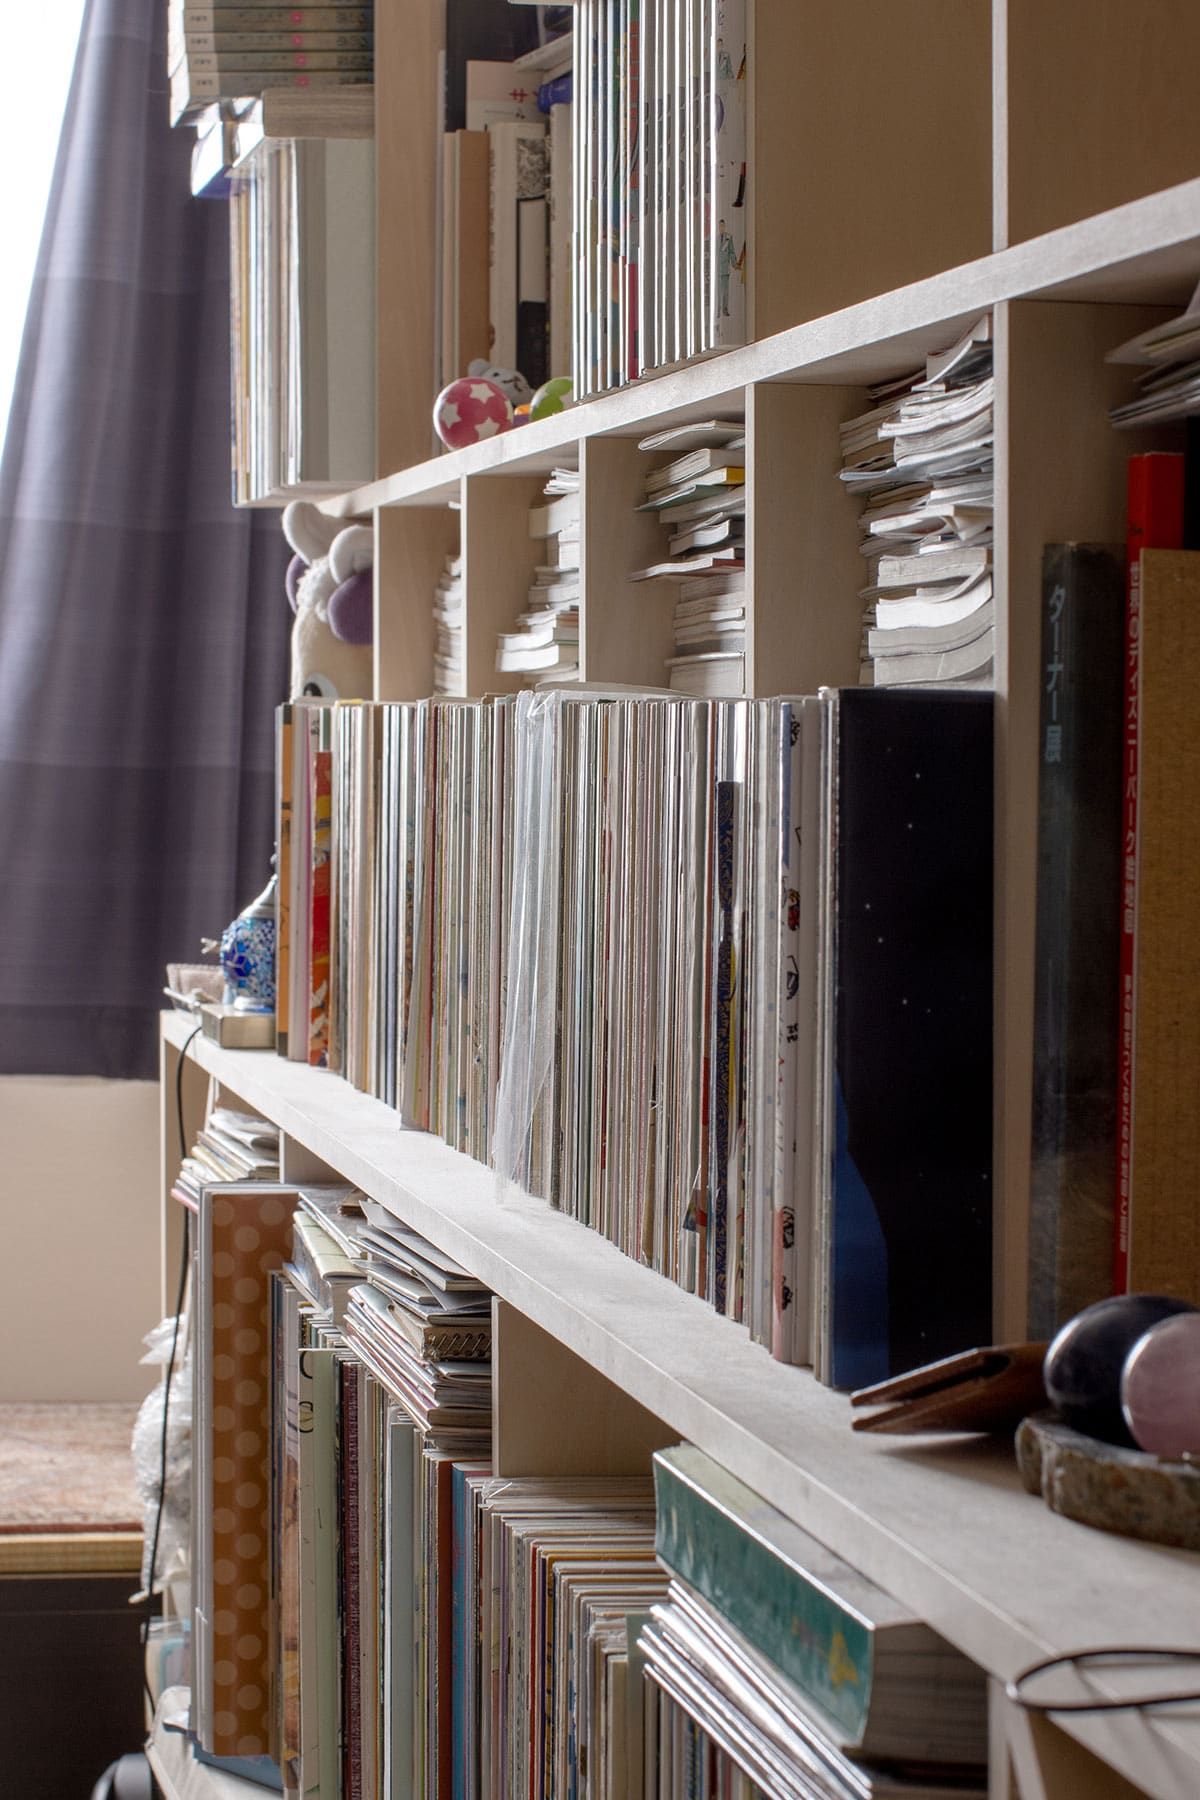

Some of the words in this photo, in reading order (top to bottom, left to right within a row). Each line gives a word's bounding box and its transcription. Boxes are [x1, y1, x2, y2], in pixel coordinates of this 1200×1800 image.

[1046, 585, 1066, 762] ターナー展
